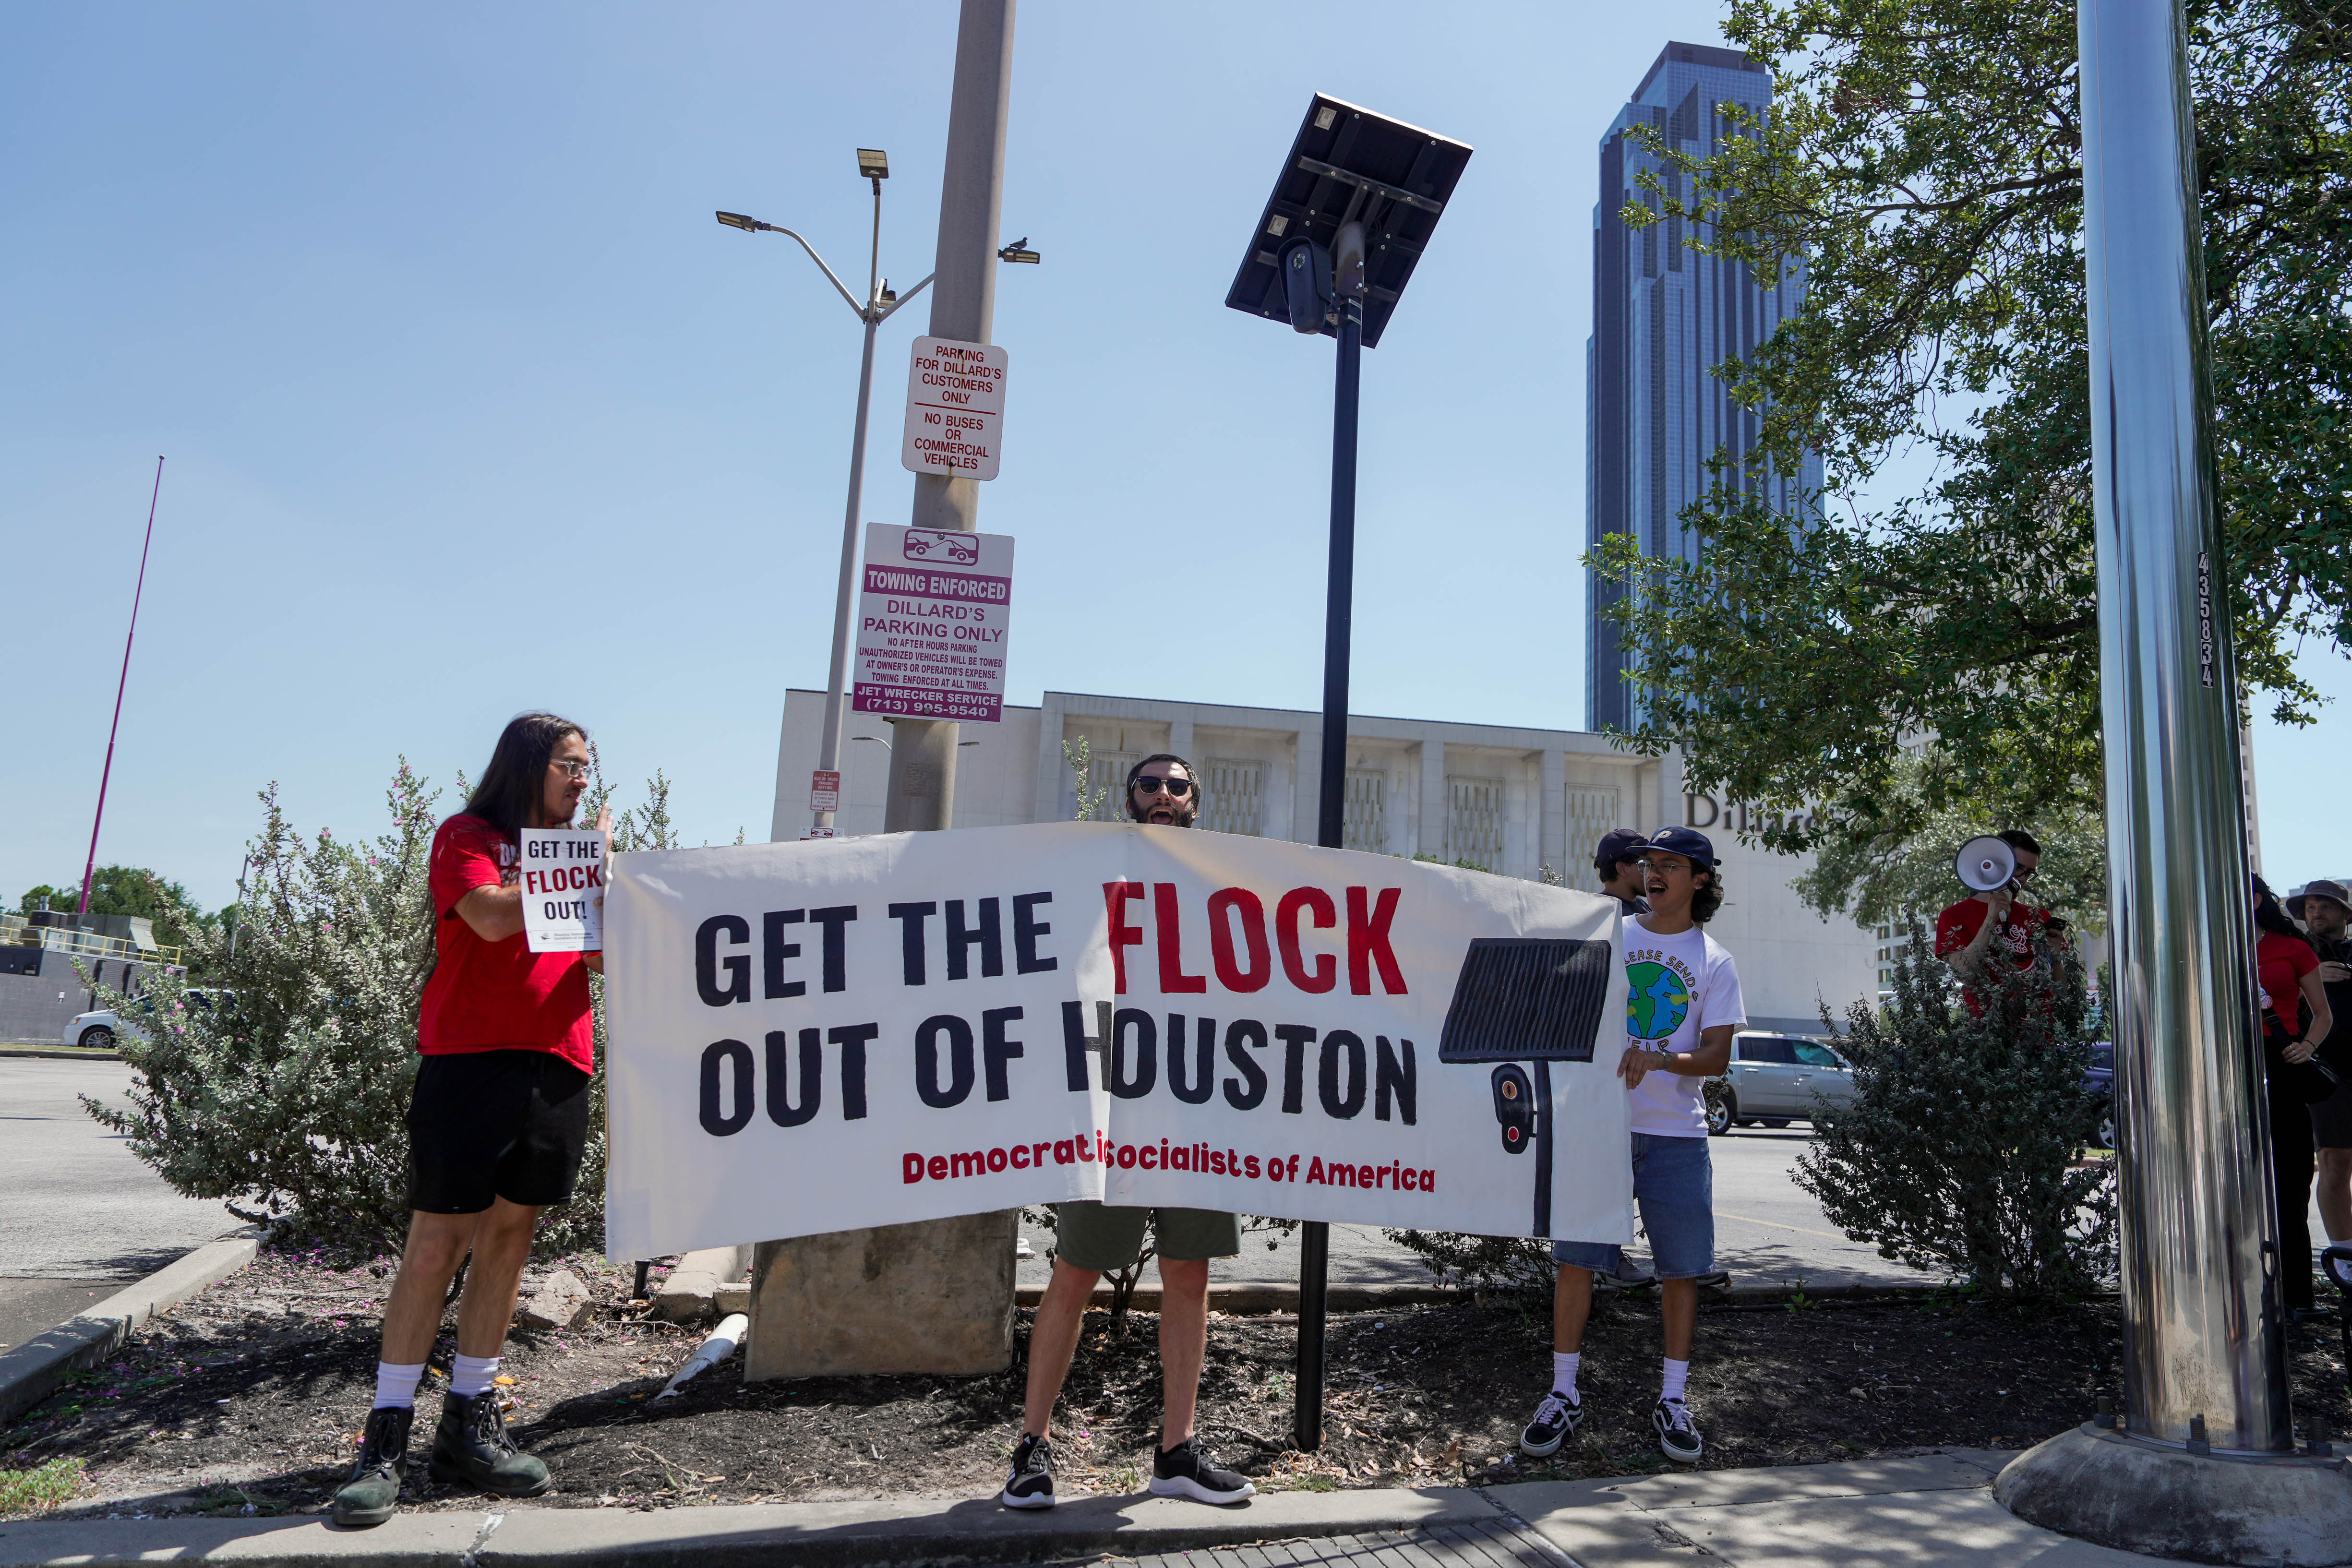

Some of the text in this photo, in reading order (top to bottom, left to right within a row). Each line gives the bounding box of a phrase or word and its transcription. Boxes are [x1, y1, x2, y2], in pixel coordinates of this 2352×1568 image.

[936, 346, 984, 362] PARKING
[916, 358, 1001, 379] FOR DILLARD'S
[922, 373, 993, 393] CUSTOMERS
[942, 391, 971, 404] ONLY
[924, 412, 984, 430] NO BUSES
[945, 429, 961, 440] OR
[914, 438, 989, 457] COMMERCIAL
[924, 453, 978, 469] VEHICLES
[868, 571, 1006, 599] TOWING ENFORCED
[888, 600, 984, 622] DILLARD'S
[864, 617, 1003, 642] PARKING ONLY
[888, 637, 977, 653] NO AFTER HOURS PARKING
[859, 647, 1003, 668] UNAUTHORIZED VEHICLES WILL BE TOWED
[866, 660, 997, 679] AT OWNER'S OR OPERATOR'S EXPENSE.
[872, 672, 988, 691] TOWING ENFORCED AT ALL TIMES.
[858, 686, 998, 706] JET WRECKER SERVICE
[866, 698, 908, 712] (713)
[528, 840, 560, 858] GET
[566, 841, 600, 858] THE
[526, 864, 603, 895] FLOCK
[544, 901, 587, 920] OUT!
[695, 881, 1408, 1007] GET THE FLOCK
[1667, 957, 1695, 987] SEND
[699, 1001, 1417, 1137] OUT OF HOUSTON
[1267, 1154, 1300, 1183] of
[1307, 1156, 1436, 1193] America
